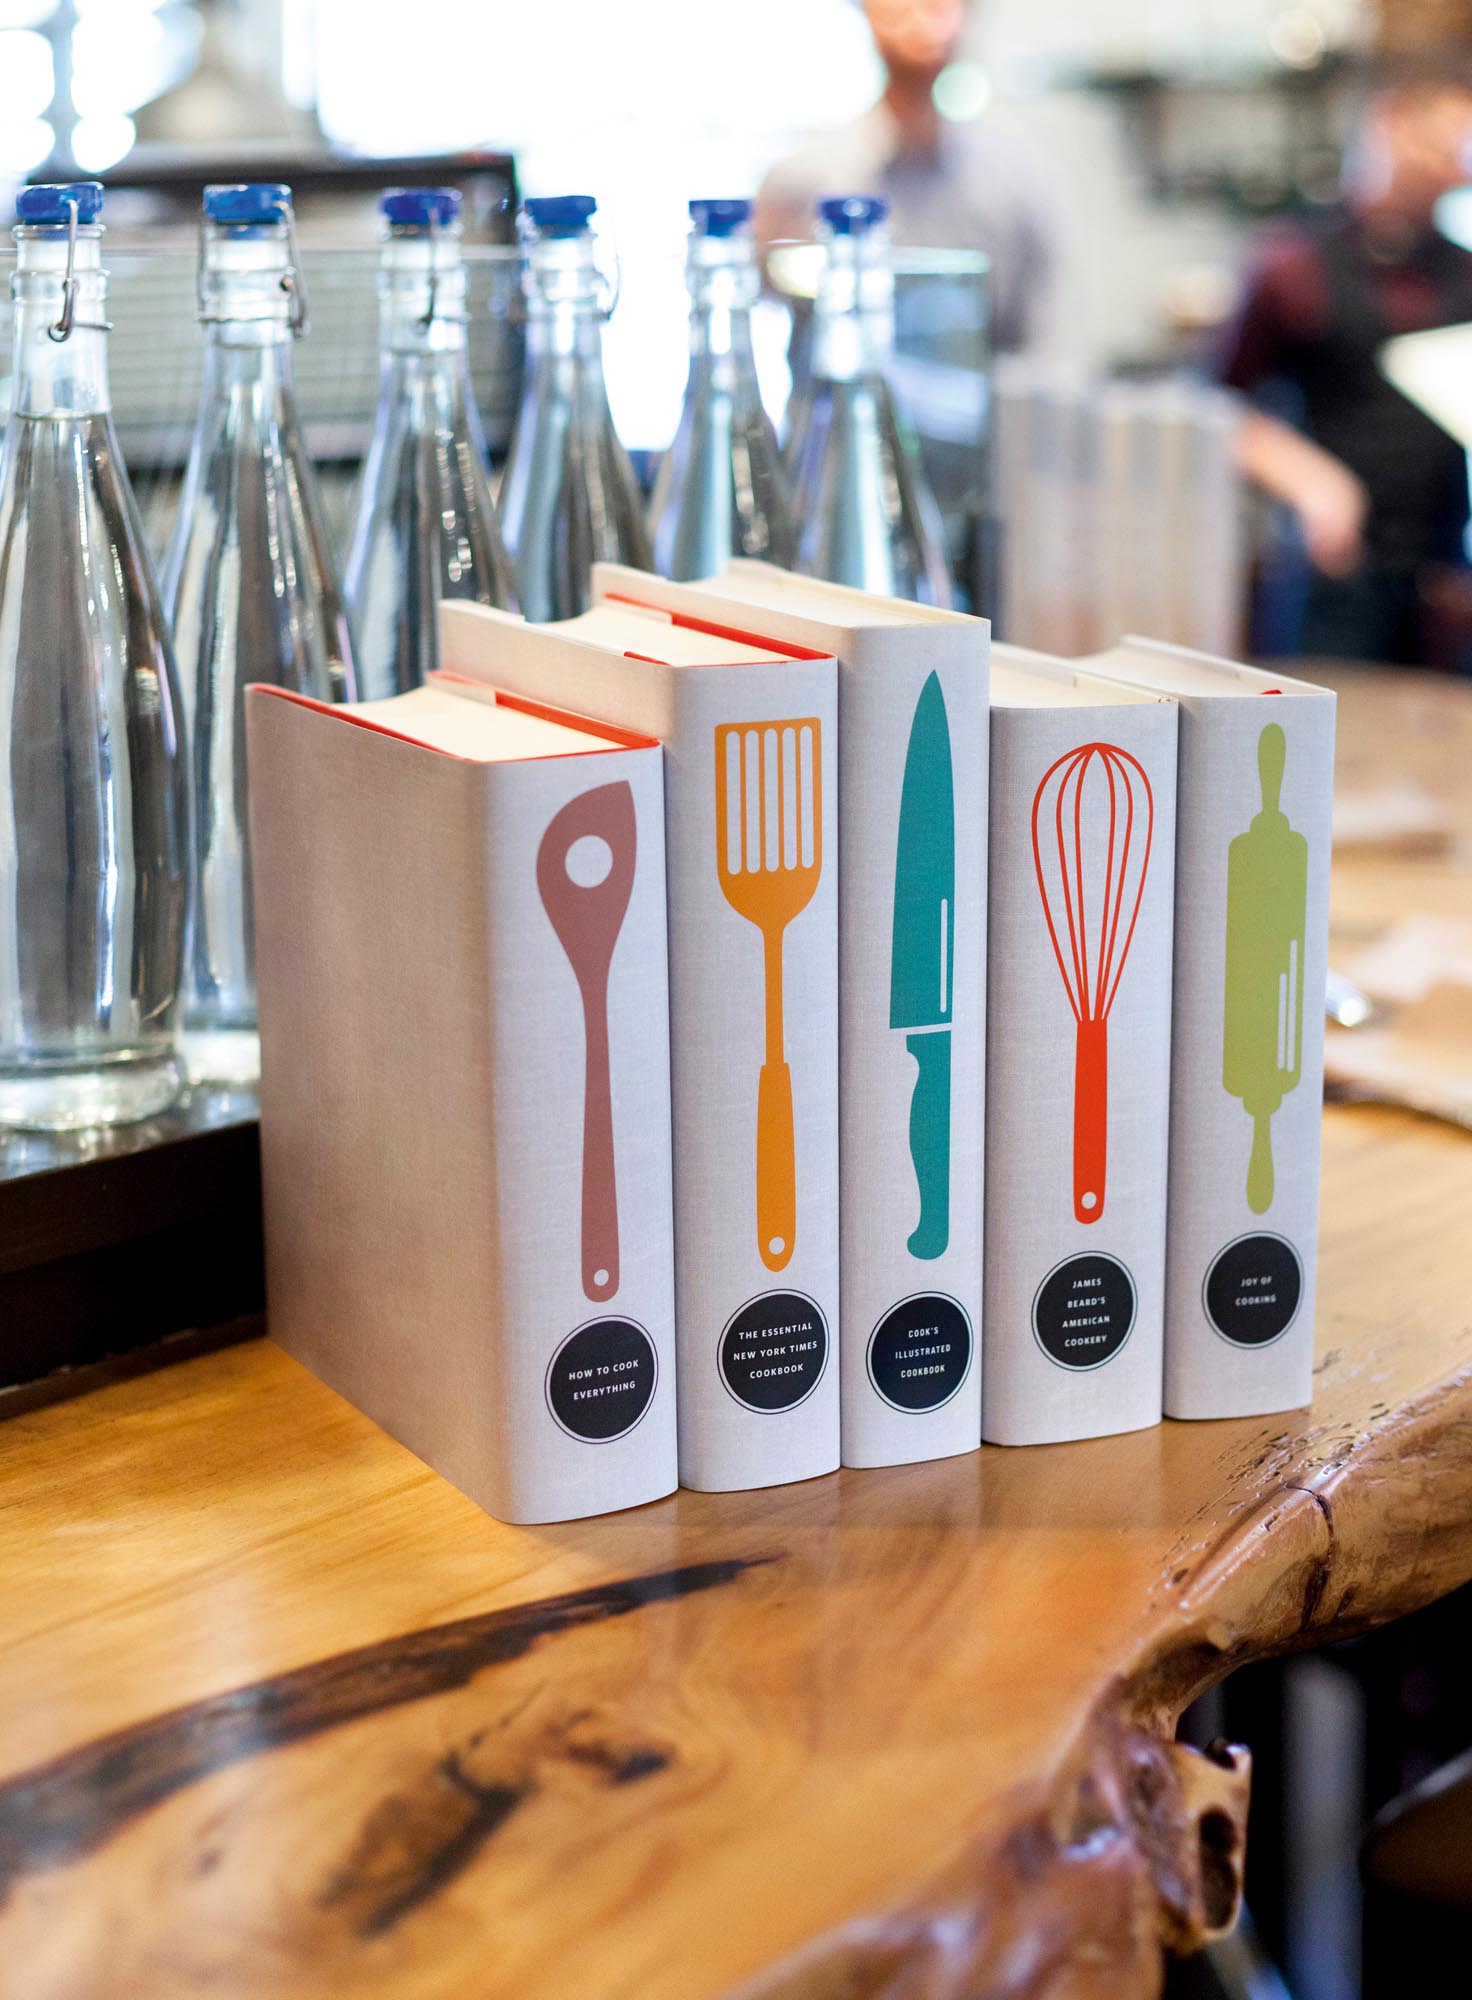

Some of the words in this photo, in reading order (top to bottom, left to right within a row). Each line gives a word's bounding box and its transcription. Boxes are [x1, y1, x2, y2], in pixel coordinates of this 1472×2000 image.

[1072, 1278, 1102, 1289] JAMES
[1241, 1277, 1258, 1287] JOY
[1260, 1275, 1272, 1285] OF
[1067, 1296, 1106, 1309] BEARD'S
[1235, 1294, 1276, 1307] COOKING
[1062, 1315, 1111, 1328] AMERICAN
[739, 1330, 758, 1340] THE
[761, 1322, 813, 1338] ESSENTIAL
[908, 1326, 939, 1338] COOK'S
[1064, 1335, 1107, 1347] COOKERY
[733, 1351, 756, 1361] NEW
[760, 1346, 786, 1358] YORK
[789, 1340, 818, 1353] TIMES
[895, 1344, 951, 1359] ILLUSTRATED
[568, 1369, 593, 1381] HOW
[597, 1366, 610, 1376] TO
[613, 1359, 639, 1372] COOK
[749, 1363, 804, 1379] COOKBOOK
[900, 1364, 945, 1378] COOKBOOK
[573, 1380, 636, 1401] EVERYTHING
